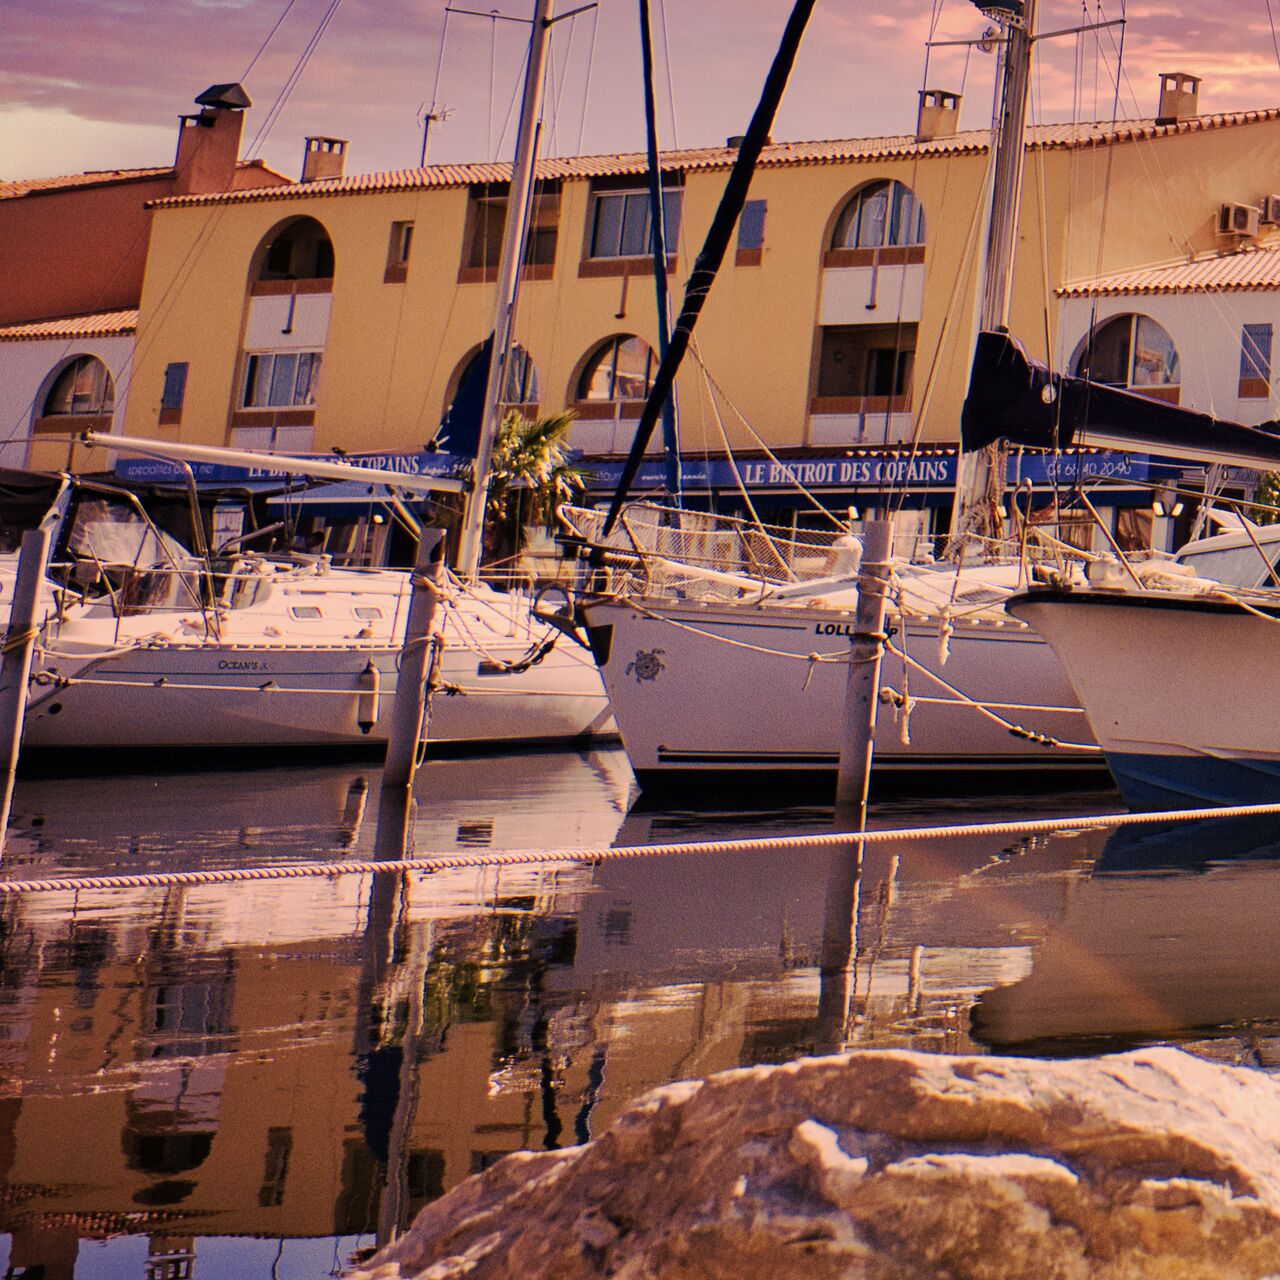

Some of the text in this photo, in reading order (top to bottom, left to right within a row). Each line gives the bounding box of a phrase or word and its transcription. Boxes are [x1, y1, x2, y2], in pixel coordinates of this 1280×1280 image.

[744, 460, 948, 484] LE BISTROT DES COPAINS
[815, 623, 899, 638] LOLLP
